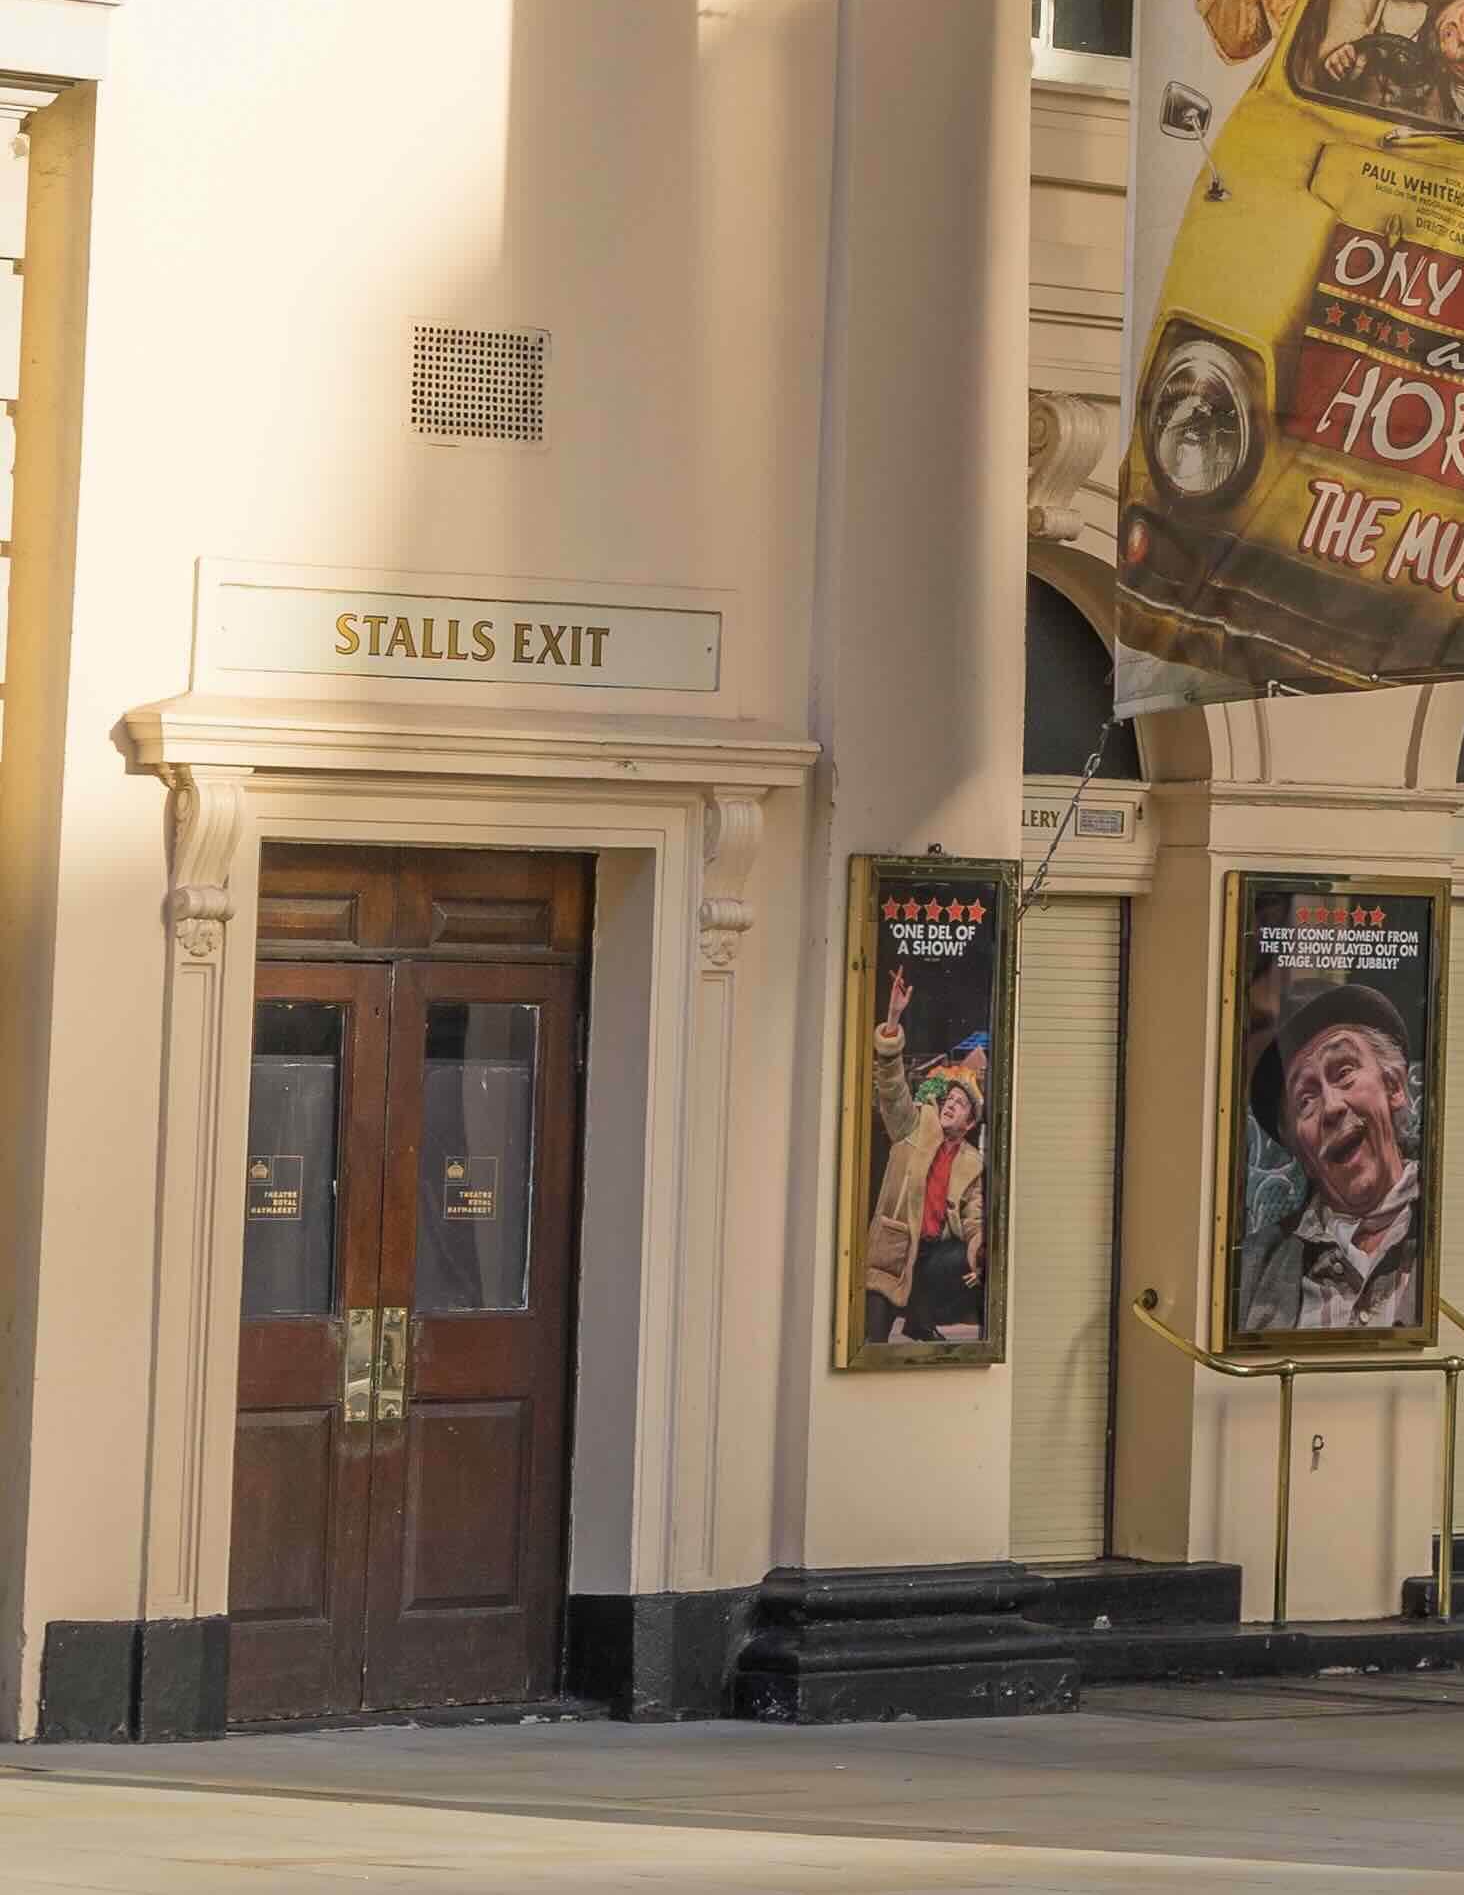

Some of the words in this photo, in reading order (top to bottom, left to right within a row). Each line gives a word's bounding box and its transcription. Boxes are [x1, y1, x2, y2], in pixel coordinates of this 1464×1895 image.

[1361, 161, 1398, 187] PAUL
[1334, 235, 1462, 317] ONLY
[1300, 479, 1402, 568] THE
[334, 612, 497, 663] STALLS
[512, 622, 611, 667] EXIT
[928, 924, 953, 940] DEL
[955, 925, 977, 942] OF
[1297, 928, 1335, 942] ICONIC
[1336, 929, 1385, 943] MOMENT
[1387, 930, 1419, 944] FROM
[897, 940, 909, 955] A
[1260, 940, 1279, 954] THE
[1281, 941, 1295, 954] TV
[1297, 941, 1333, 955] SHOW
[1334, 942, 1373, 956] PLAYED
[1375, 944, 1398, 957] OUT
[1399, 944, 1418, 957] ON
[1316, 955, 1354, 969] LOVELY
